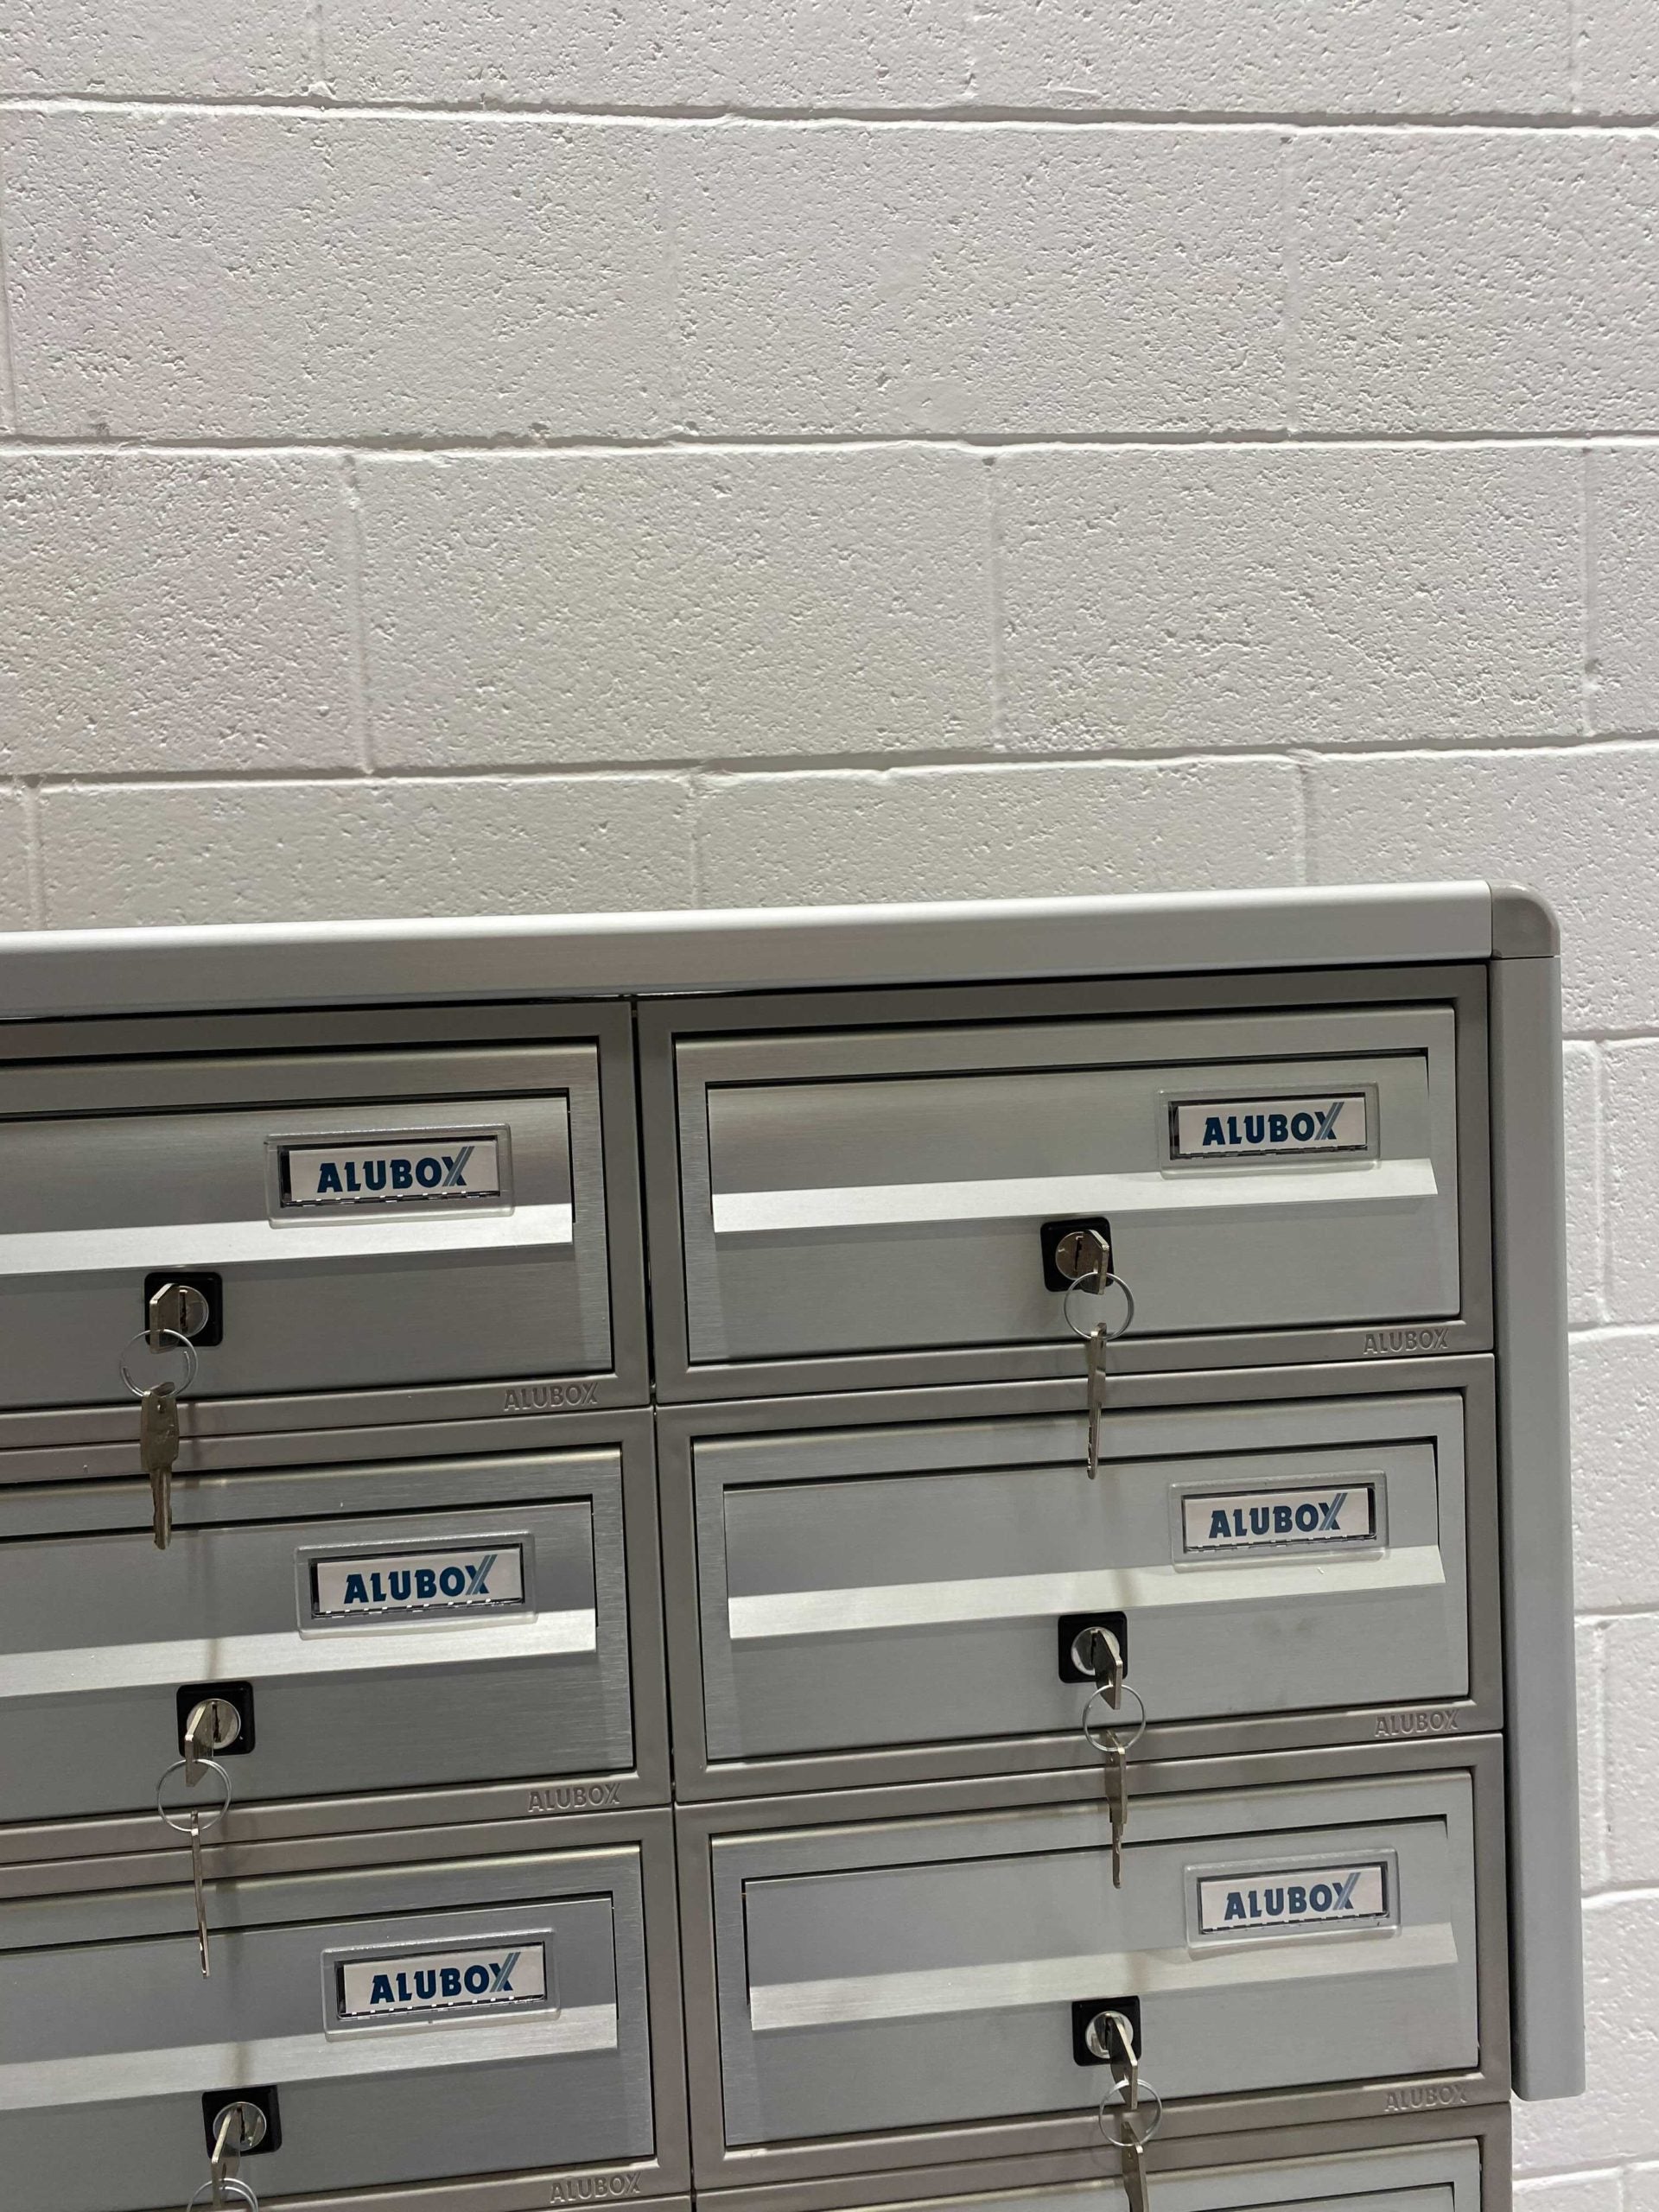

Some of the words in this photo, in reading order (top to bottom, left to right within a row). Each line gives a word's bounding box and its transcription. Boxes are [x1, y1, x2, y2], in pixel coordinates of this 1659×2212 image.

[1202, 1102, 1345, 1146] ALUBOX
[316, 1146, 474, 1193] ALUBOX
[1363, 1328, 1449, 1355] ALUBOX
[504, 1382, 599, 1410] ALUBOX
[1209, 1492, 1347, 1539] ALUBOX
[343, 1554, 498, 1605] ALUBOX
[1375, 1709, 1459, 1738] ALUBOX
[528, 1783, 620, 1813] ALUBOX
[1224, 1872, 1362, 1921] ALUBOX
[369, 1951, 521, 2005] ALUBOX
[1384, 2083, 1468, 2113] ALUBOX
[550, 2172, 640, 2204] ALUBOX
